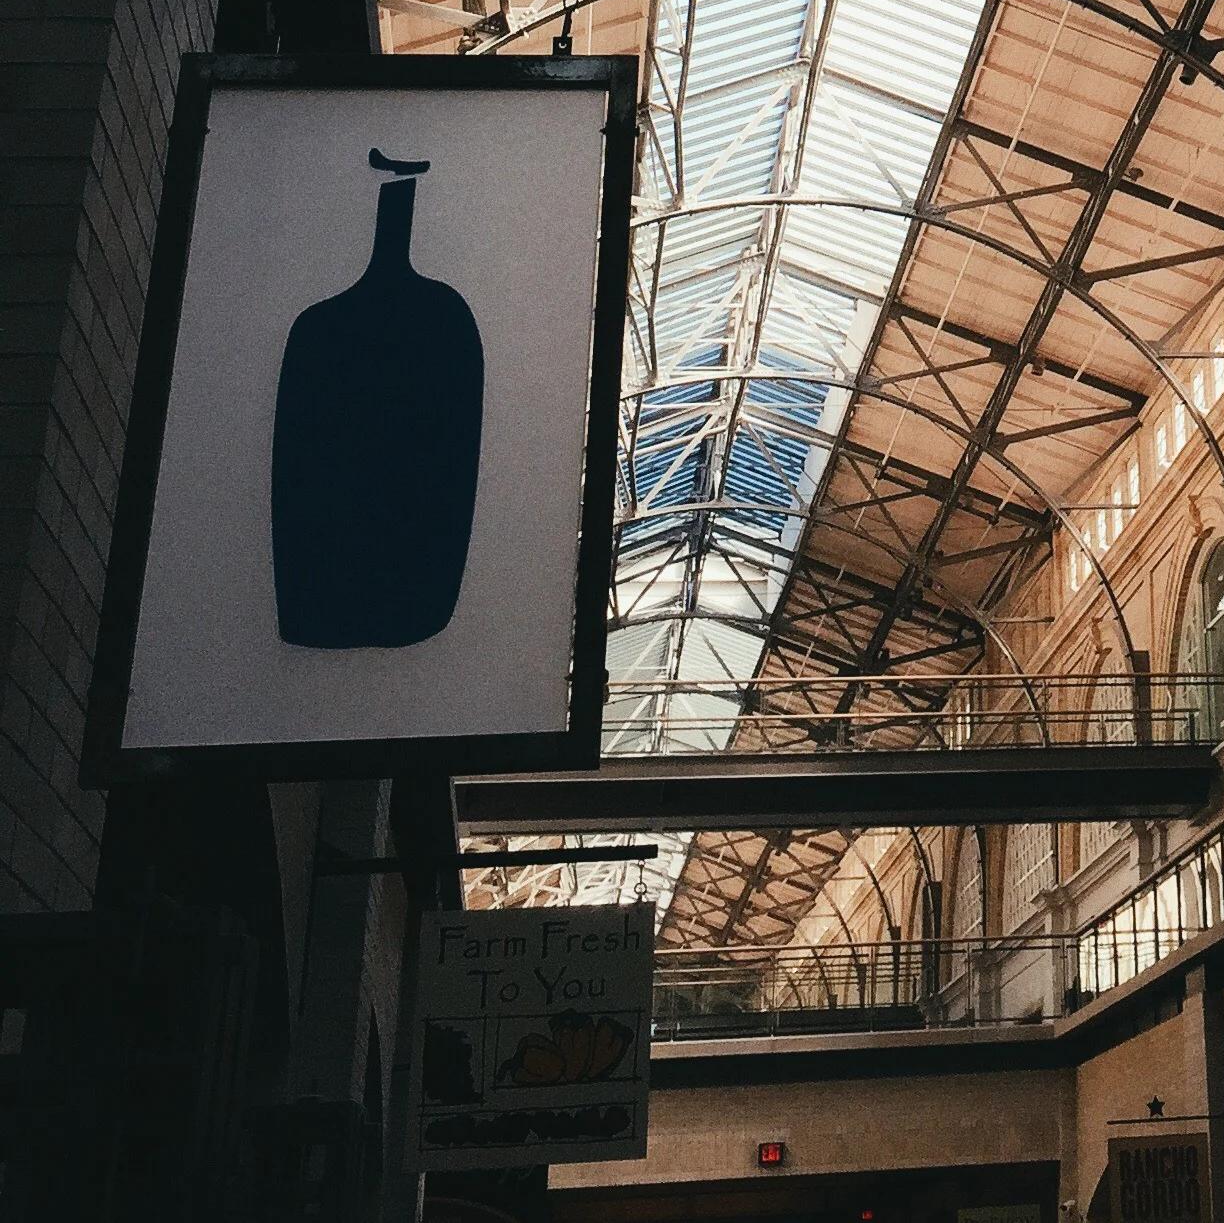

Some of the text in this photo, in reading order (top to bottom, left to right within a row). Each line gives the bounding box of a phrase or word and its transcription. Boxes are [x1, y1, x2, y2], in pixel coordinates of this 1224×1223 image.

[438, 914, 640, 964] Farm Fresh
[466, 966, 606, 1009] To You
[762, 1144, 780, 1161] EXIT
[1119, 1146, 1198, 1180] RANCHO
[1120, 1178, 1200, 1219] GORDO
